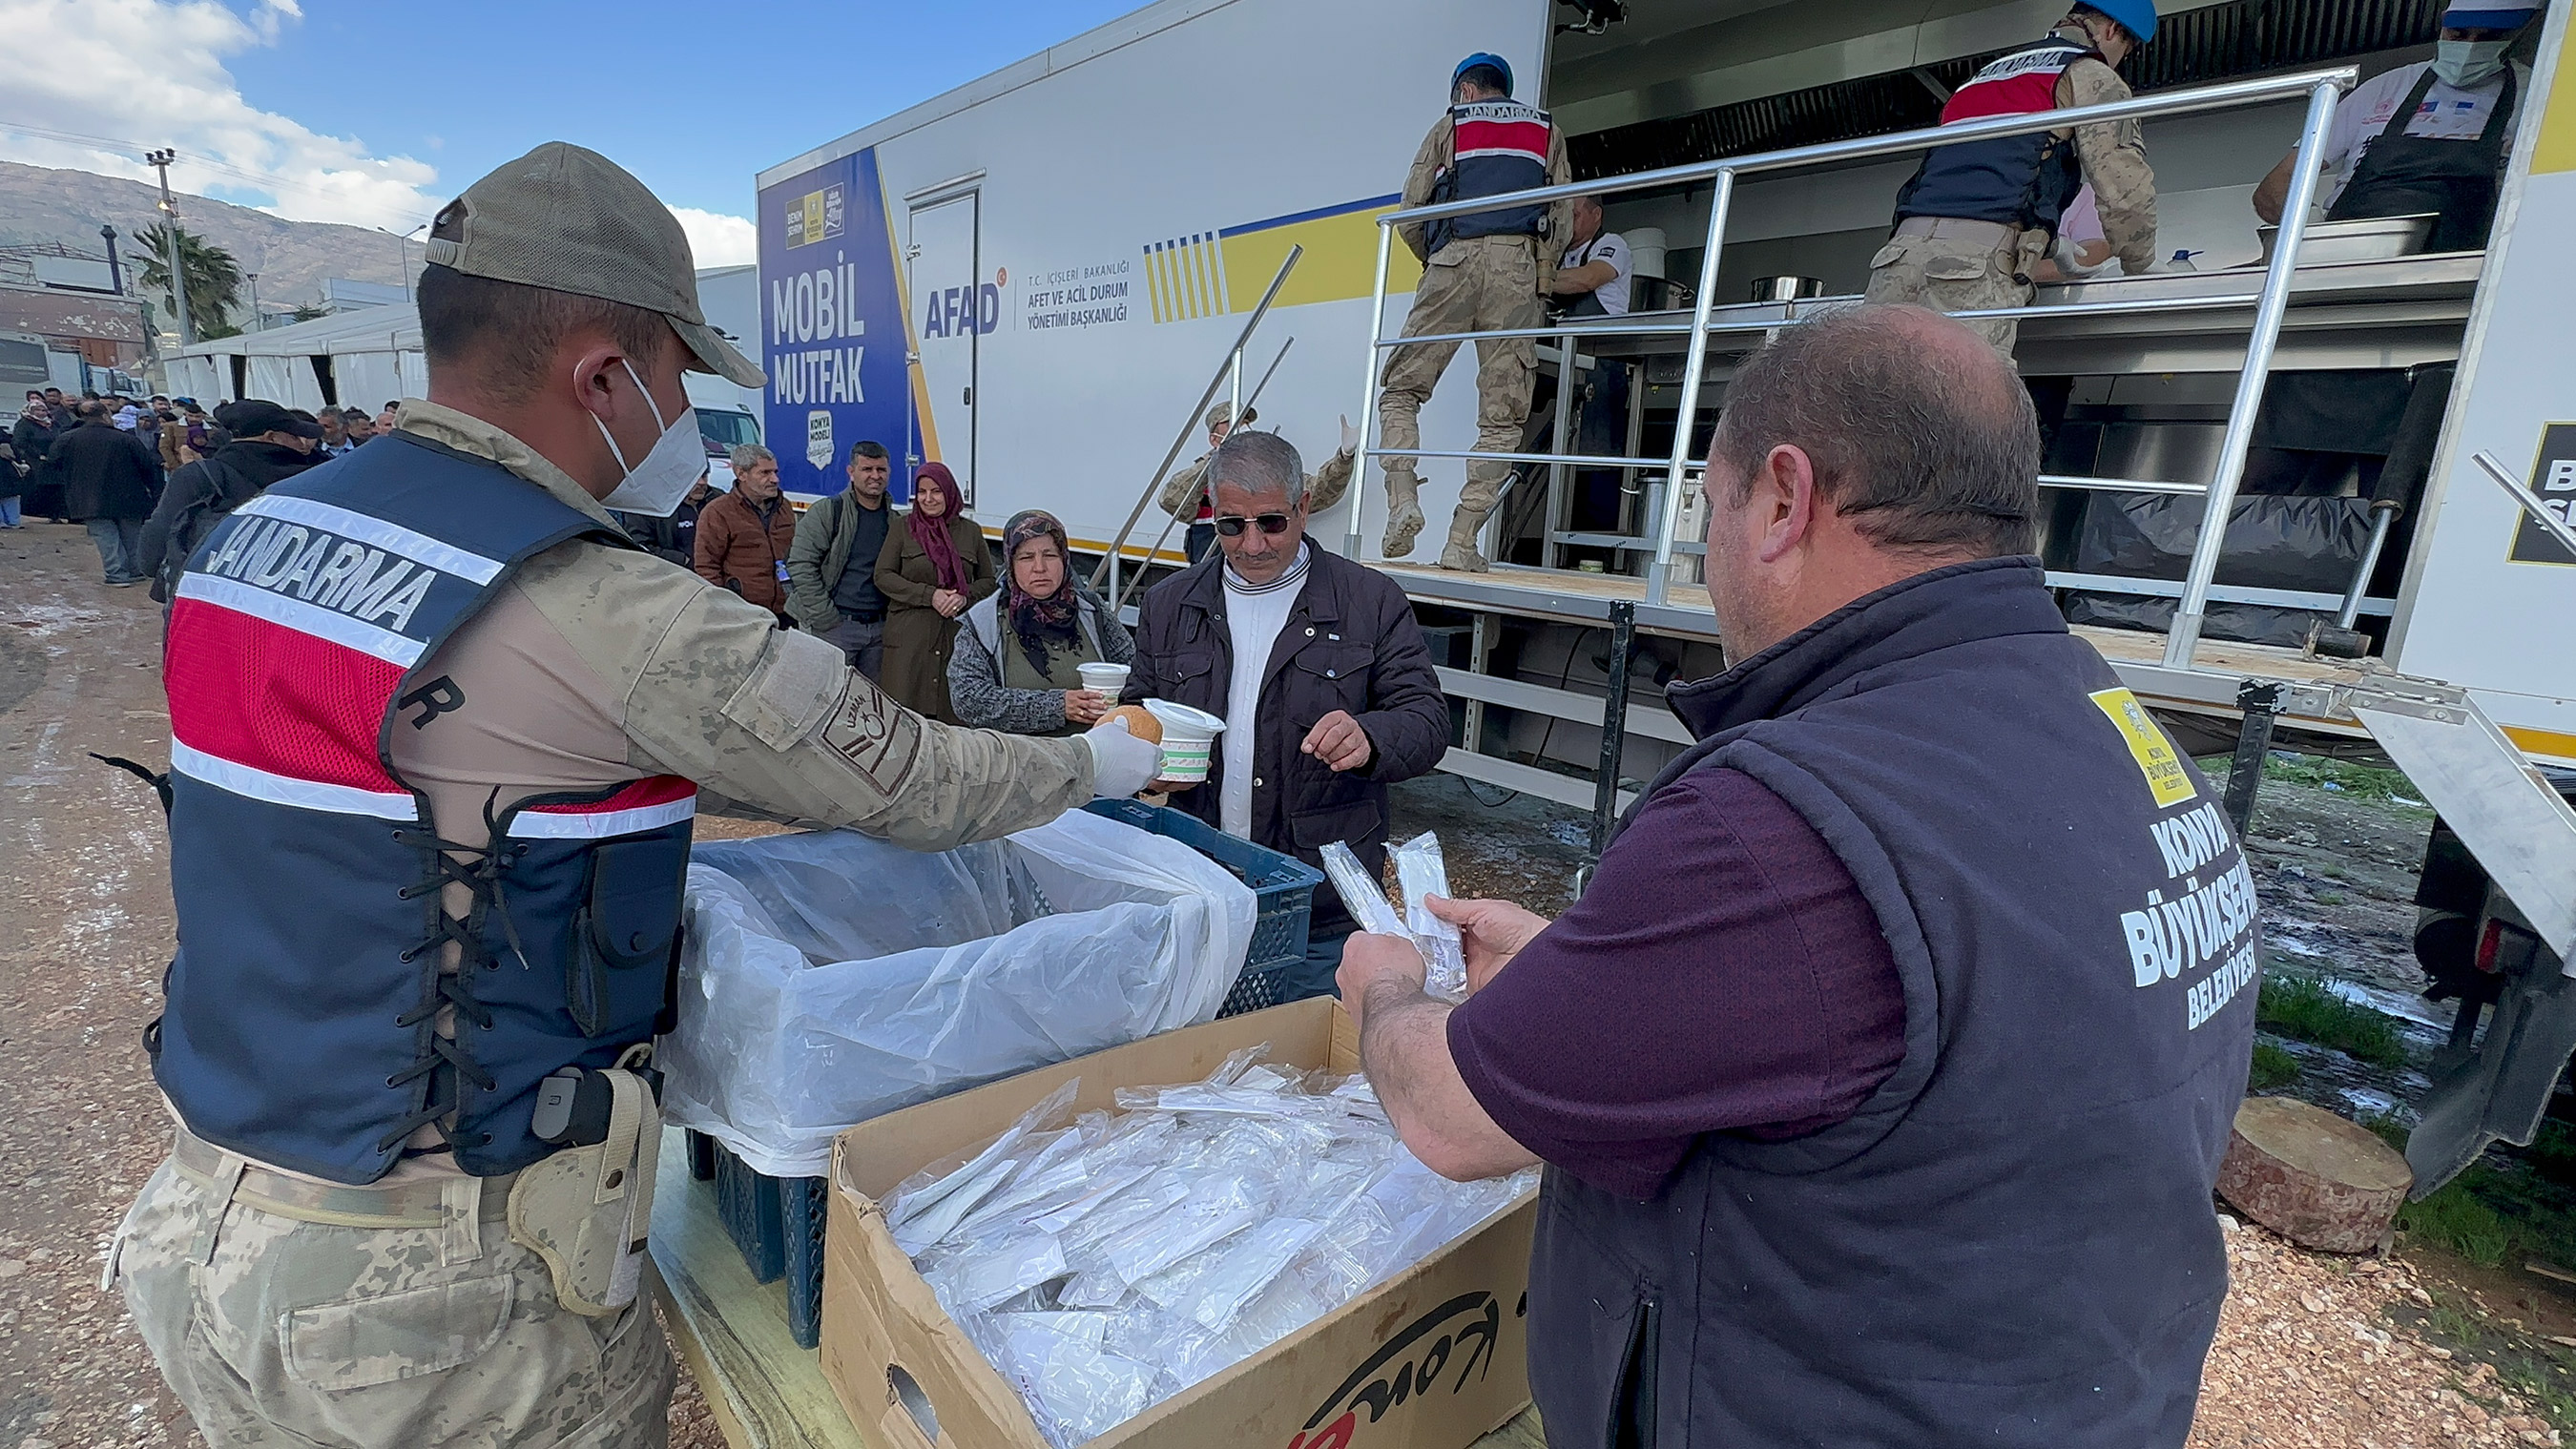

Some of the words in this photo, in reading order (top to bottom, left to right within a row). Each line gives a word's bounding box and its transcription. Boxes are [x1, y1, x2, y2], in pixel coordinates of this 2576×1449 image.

[1465, 105, 1542, 121] JANDARMA
[773, 250, 865, 346] MOBİL
[1028, 275, 1043, 287] T.C.
[1047, 268, 1079, 285] İÇİŞLERİ
[1084, 259, 1130, 281] BAKANLIĞI
[1028, 292, 1051, 309] AFET
[1051, 290, 1064, 305] VE
[1066, 285, 1088, 304] ACİL
[1090, 281, 1129, 300] DURUM
[924, 283, 999, 340] AFAD
[1028, 309, 1070, 331] YÖNETİMİ
[1070, 301, 1128, 330] BAŞKANLIĞI
[774, 346, 865, 405] MUTFAK
[810, 416, 830, 430] KONYA
[207, 515, 437, 632] JANDARMA
[398, 674, 466, 731] R
[2150, 801, 2231, 879] KONYA
[2187, 929, 2256, 1031] BELEDİYESİ
